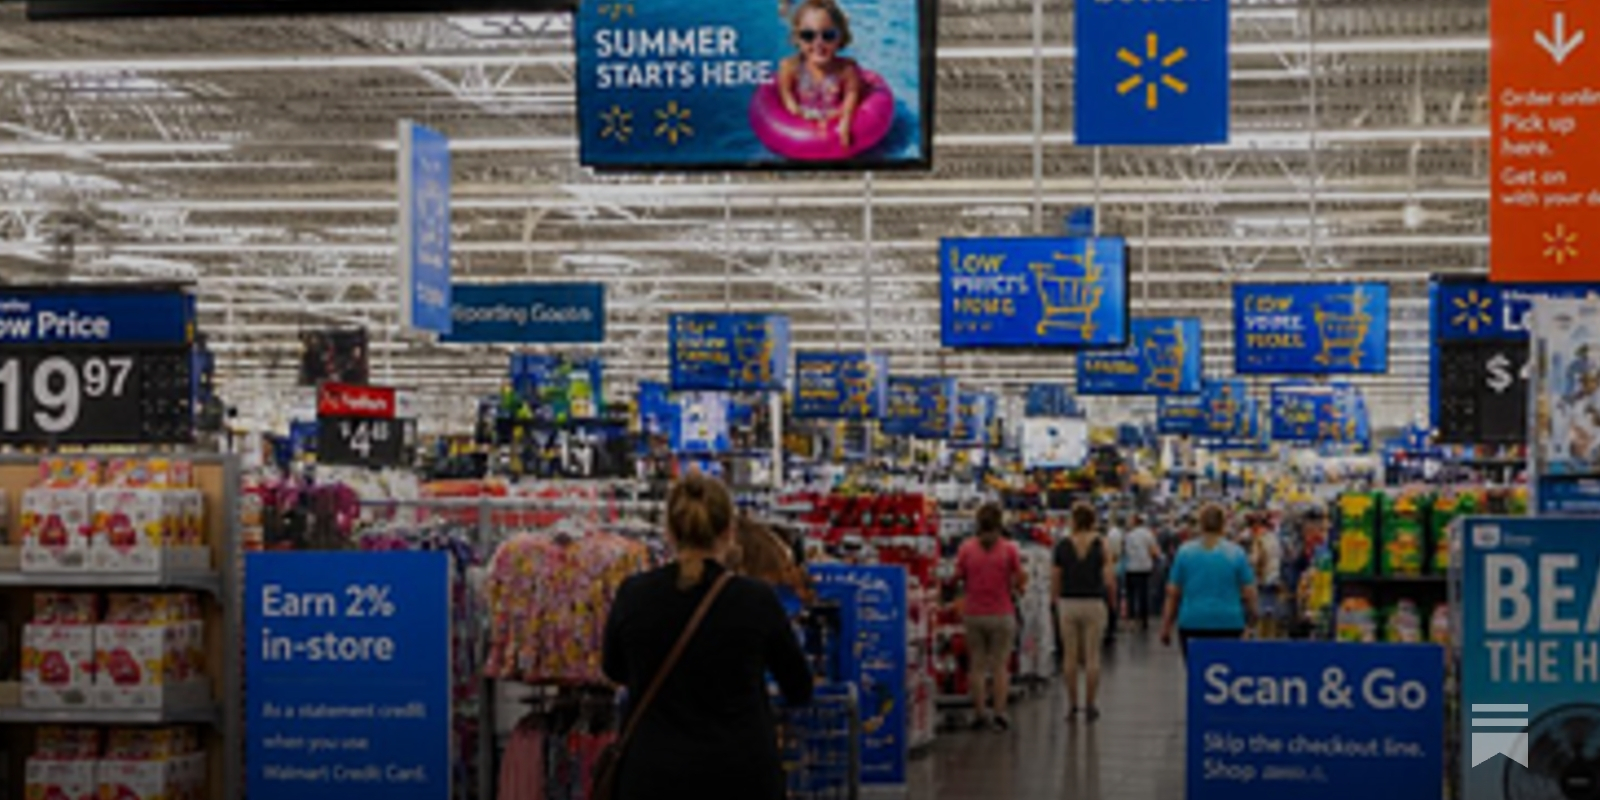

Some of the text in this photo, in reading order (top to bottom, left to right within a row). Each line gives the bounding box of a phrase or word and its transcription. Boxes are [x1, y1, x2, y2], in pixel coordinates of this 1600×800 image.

[594, 27, 739, 58] SUMMER
[596, 60, 775, 89] STARTS HERE
[1500, 88, 1554, 106] Order
[1500, 112, 1576, 136] Pick up
[1500, 167, 1567, 186] Get on
[1500, 190, 1540, 206] with
[1543, 193, 1583, 209] your
[37, 311, 111, 339] Price
[261, 583, 397, 618] Earn 2%
[261, 627, 396, 662] in-store
[1484, 640, 1561, 684] THE
[1203, 662, 1429, 711] Scan & Go
[298, 702, 375, 719] statement
[1203, 731, 1426, 760] Skip the checkout line.
[1203, 758, 1258, 785] Shop
